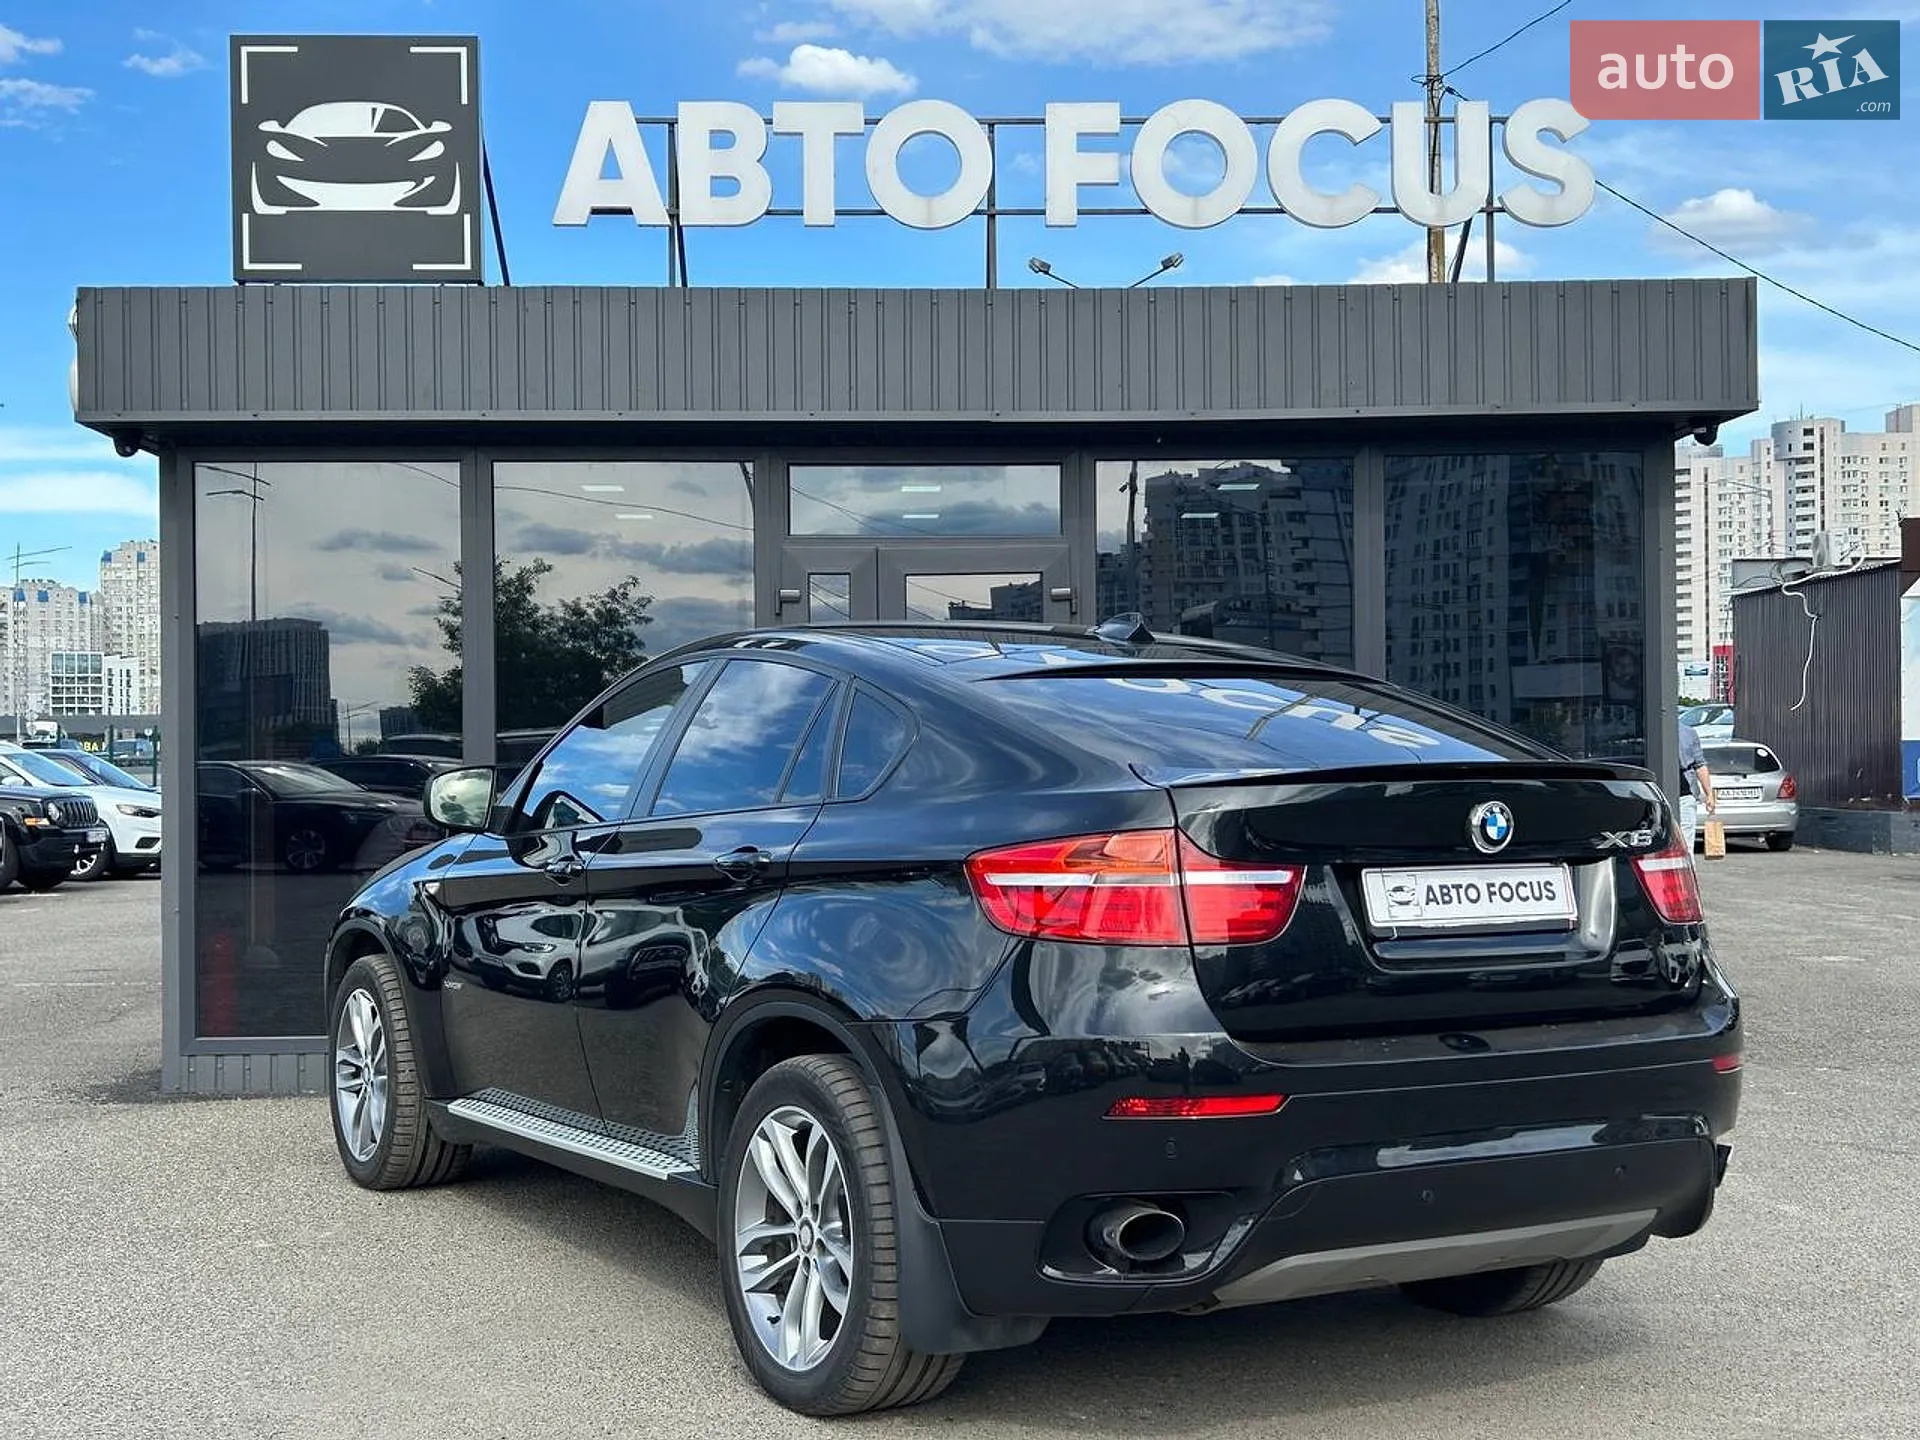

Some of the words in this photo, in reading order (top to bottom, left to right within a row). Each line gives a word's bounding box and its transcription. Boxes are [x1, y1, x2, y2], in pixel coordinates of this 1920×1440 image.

[552, 99, 993, 230] АВТО
[1045, 98, 1597, 229] FOCUS
[1596, 829, 1652, 849] X6
[1425, 883, 1480, 905] АВТО
[1486, 880, 1556, 902] FOCUS
